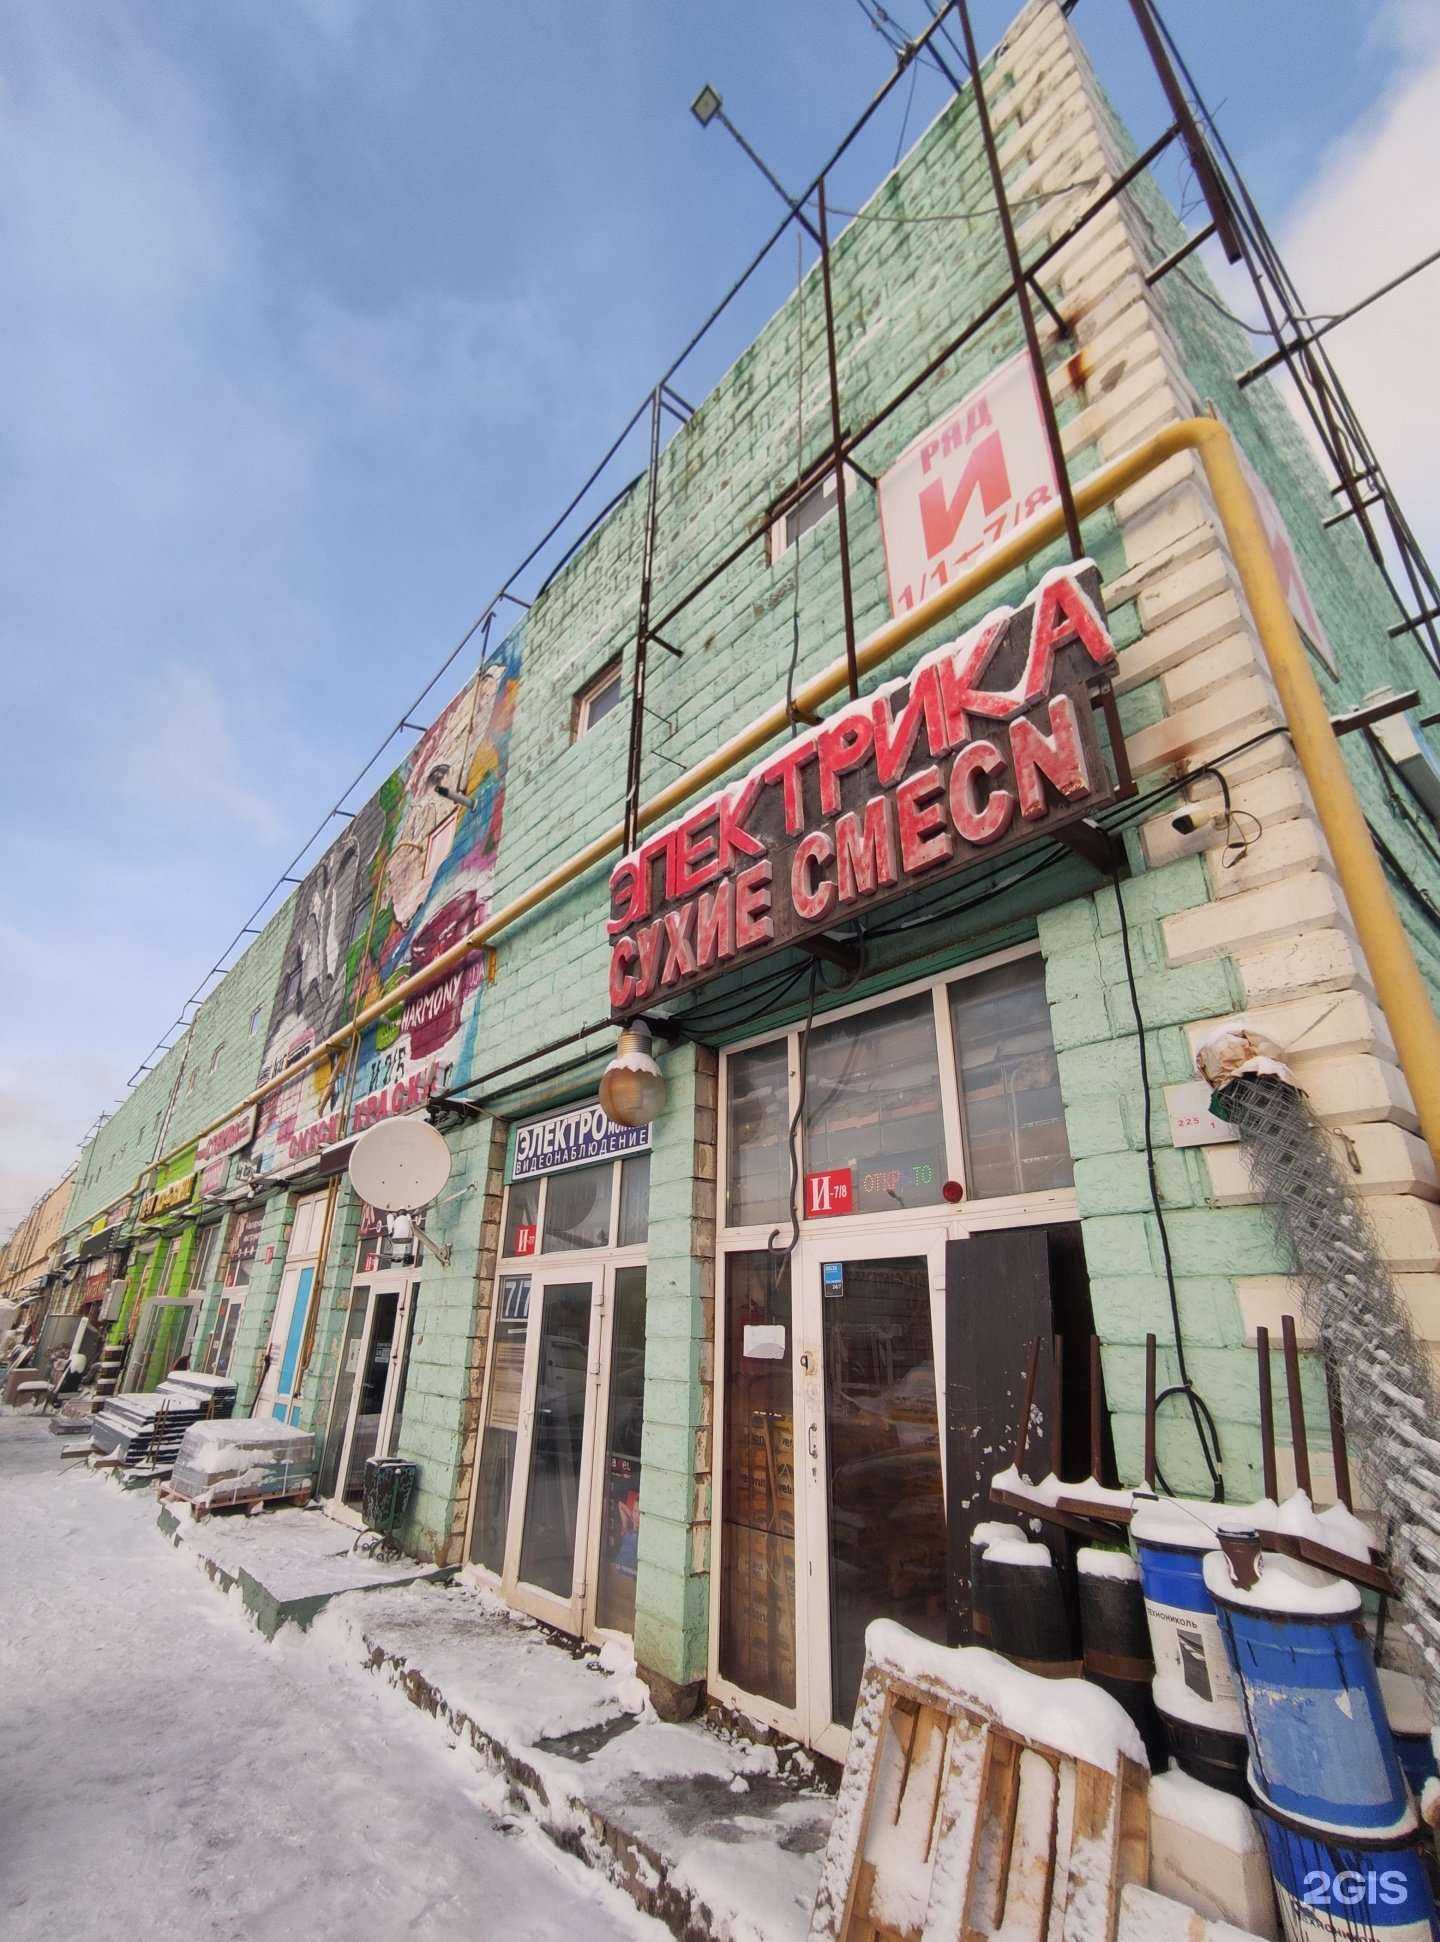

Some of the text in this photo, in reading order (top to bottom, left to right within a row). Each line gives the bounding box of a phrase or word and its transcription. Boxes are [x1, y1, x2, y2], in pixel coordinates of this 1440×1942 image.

[920, 396, 993, 475] РЯД
[918, 430, 1012, 560] И
[609, 858, 774, 1008] СУХИЕ
[401, 971, 464, 1032] HARMONY
[515, 1129, 648, 1175] ВИДЕОНАБЛЮДЕНИЕ
[518, 1109, 608, 1161] ЭЛЕКТРО
[809, 1175, 848, 1213] И-7/8
